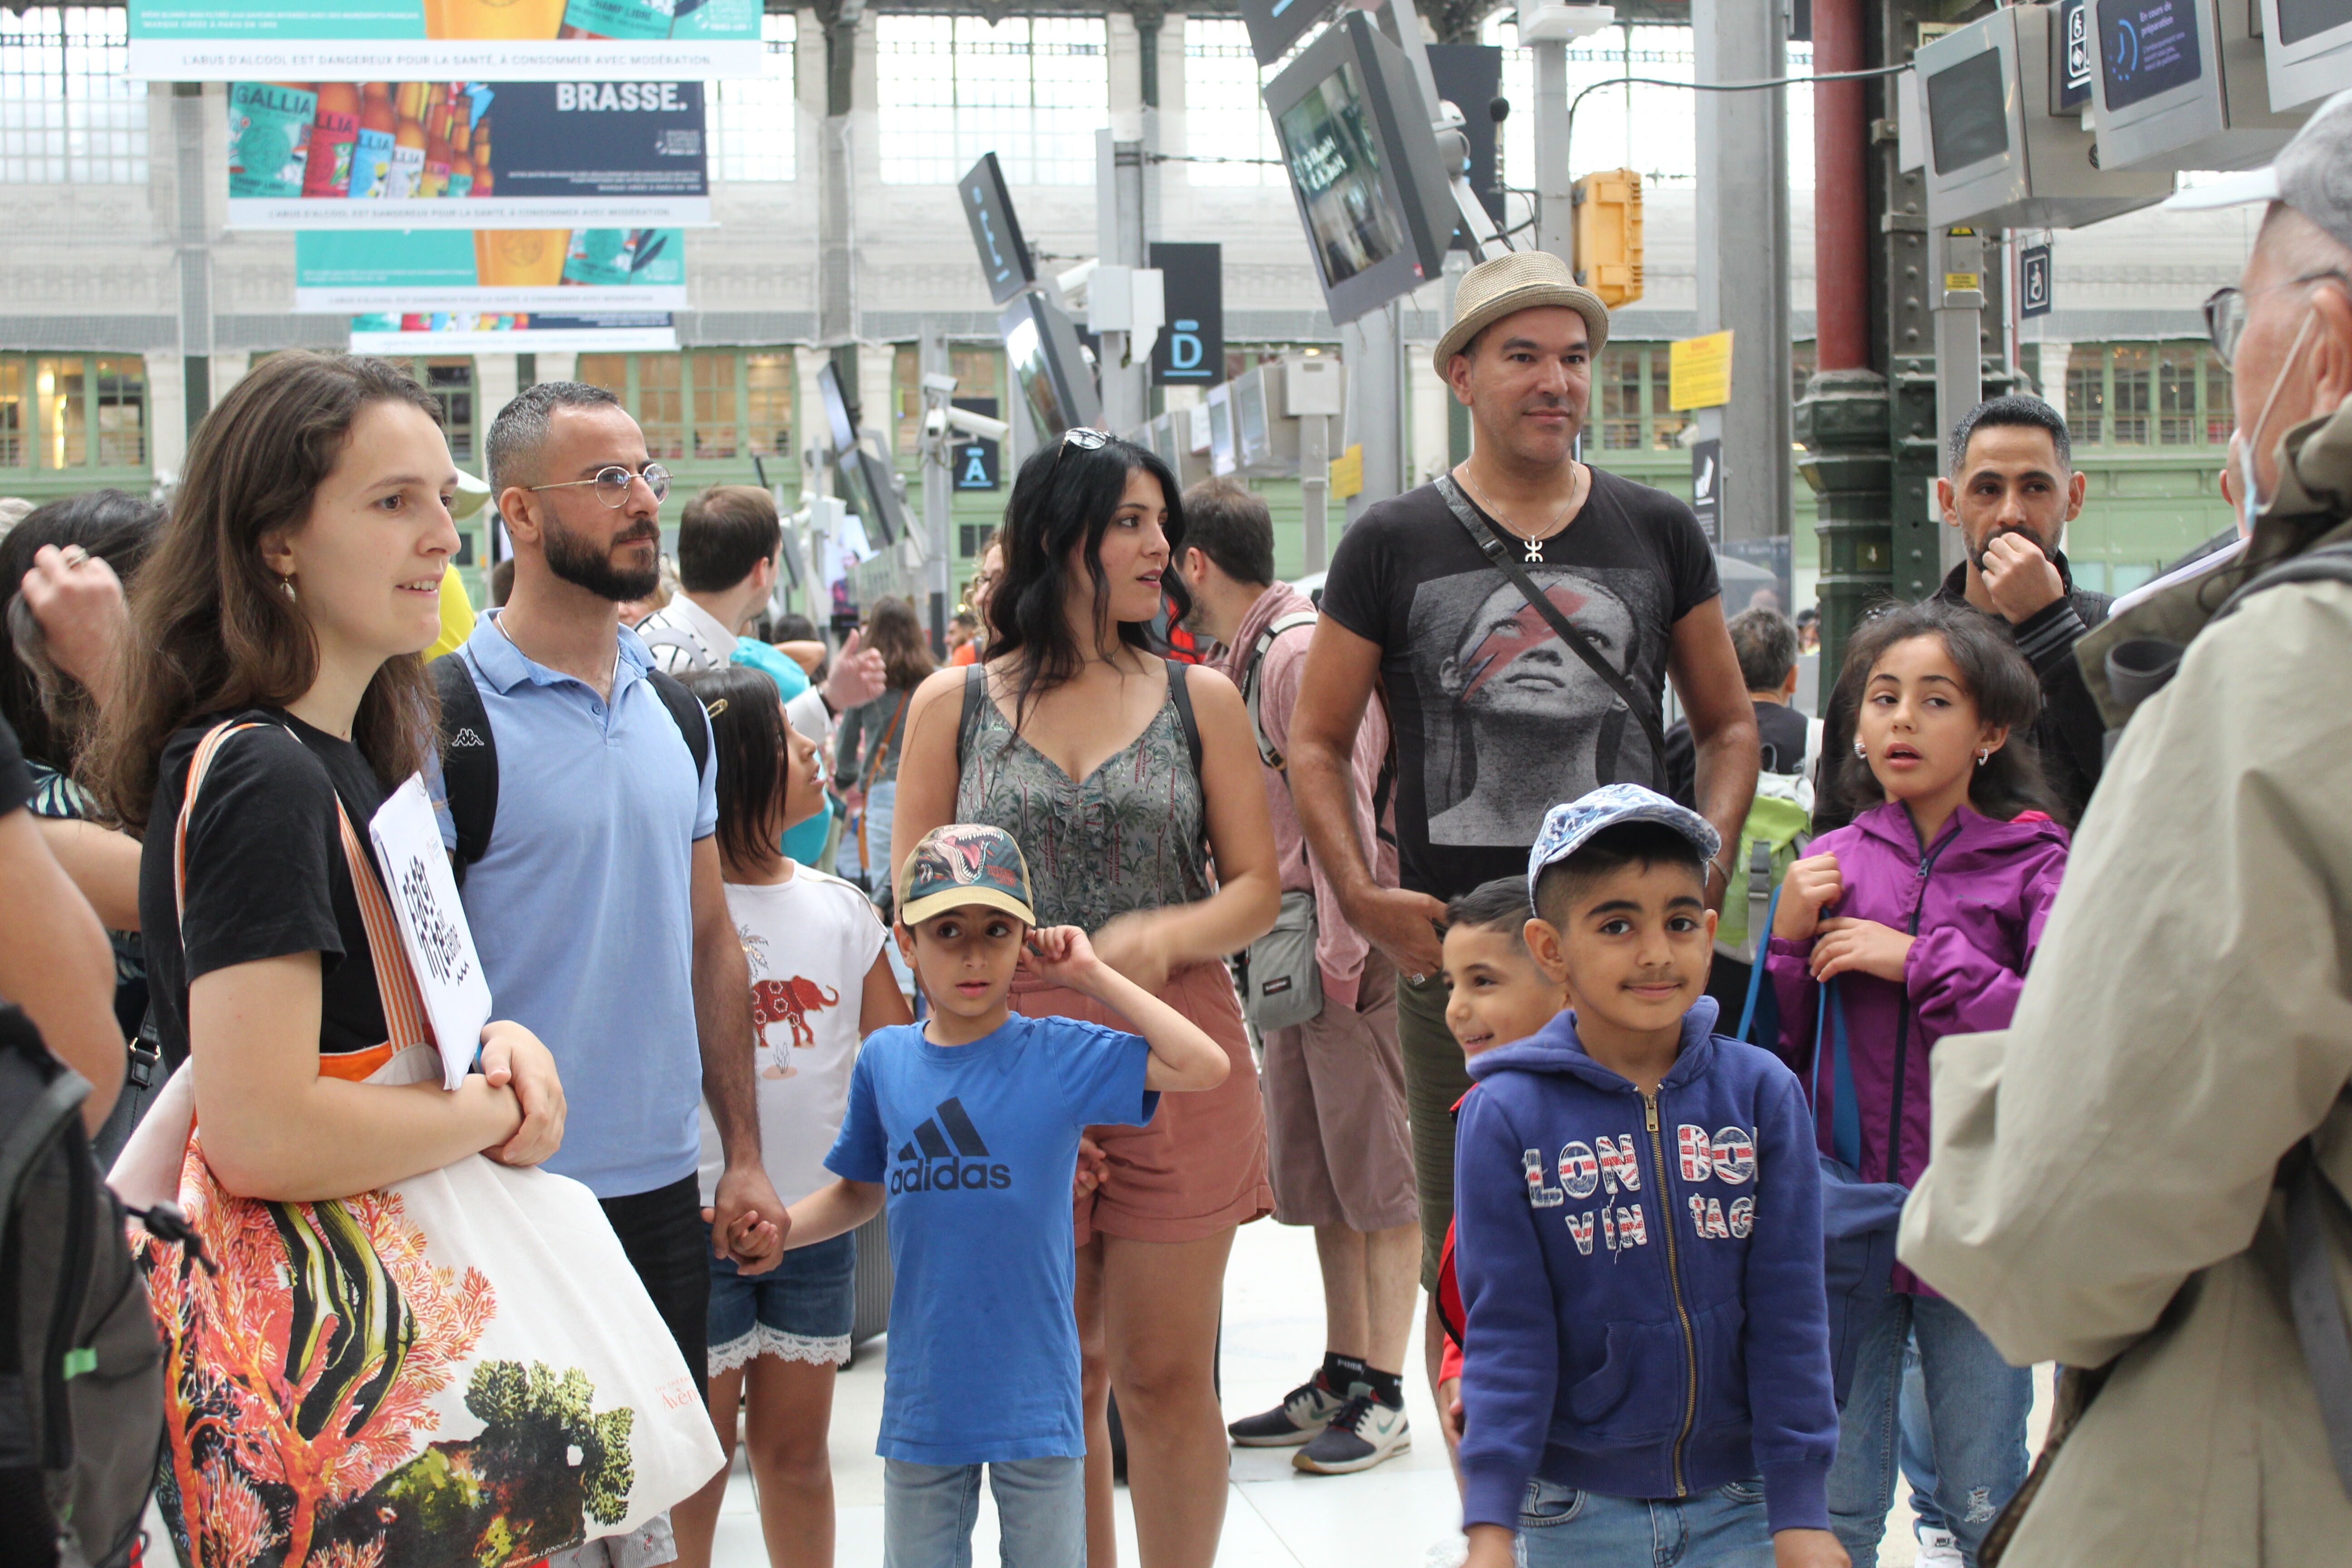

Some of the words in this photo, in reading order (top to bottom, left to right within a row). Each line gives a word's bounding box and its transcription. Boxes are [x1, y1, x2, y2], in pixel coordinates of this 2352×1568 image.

[182, 55, 224, 66] L'ABUS
[229, 55, 287, 66] D'ALCOOL
[291, 55, 315, 66] EST
[319, 55, 392, 65] DANGEREUX
[397, 55, 430, 65] POUR
[434, 55, 449, 65] LA
[511, 54, 591, 65] CONSOMMER
[595, 54, 626, 65] AVEC
[236, 85, 312, 115] GALLIA
[556, 83, 688, 112] BRASSE.
[314, 113, 352, 132] LLIA
[1171, 333, 1202, 369] D
[964, 457, 987, 481] A
[891, 1157, 1012, 1195] adidas
[1521, 1133, 1641, 1209] LON
[1677, 1124, 1759, 1185] DO
[1565, 1204, 1647, 1255] VIN
[1688, 1192, 1756, 1239] TAG
